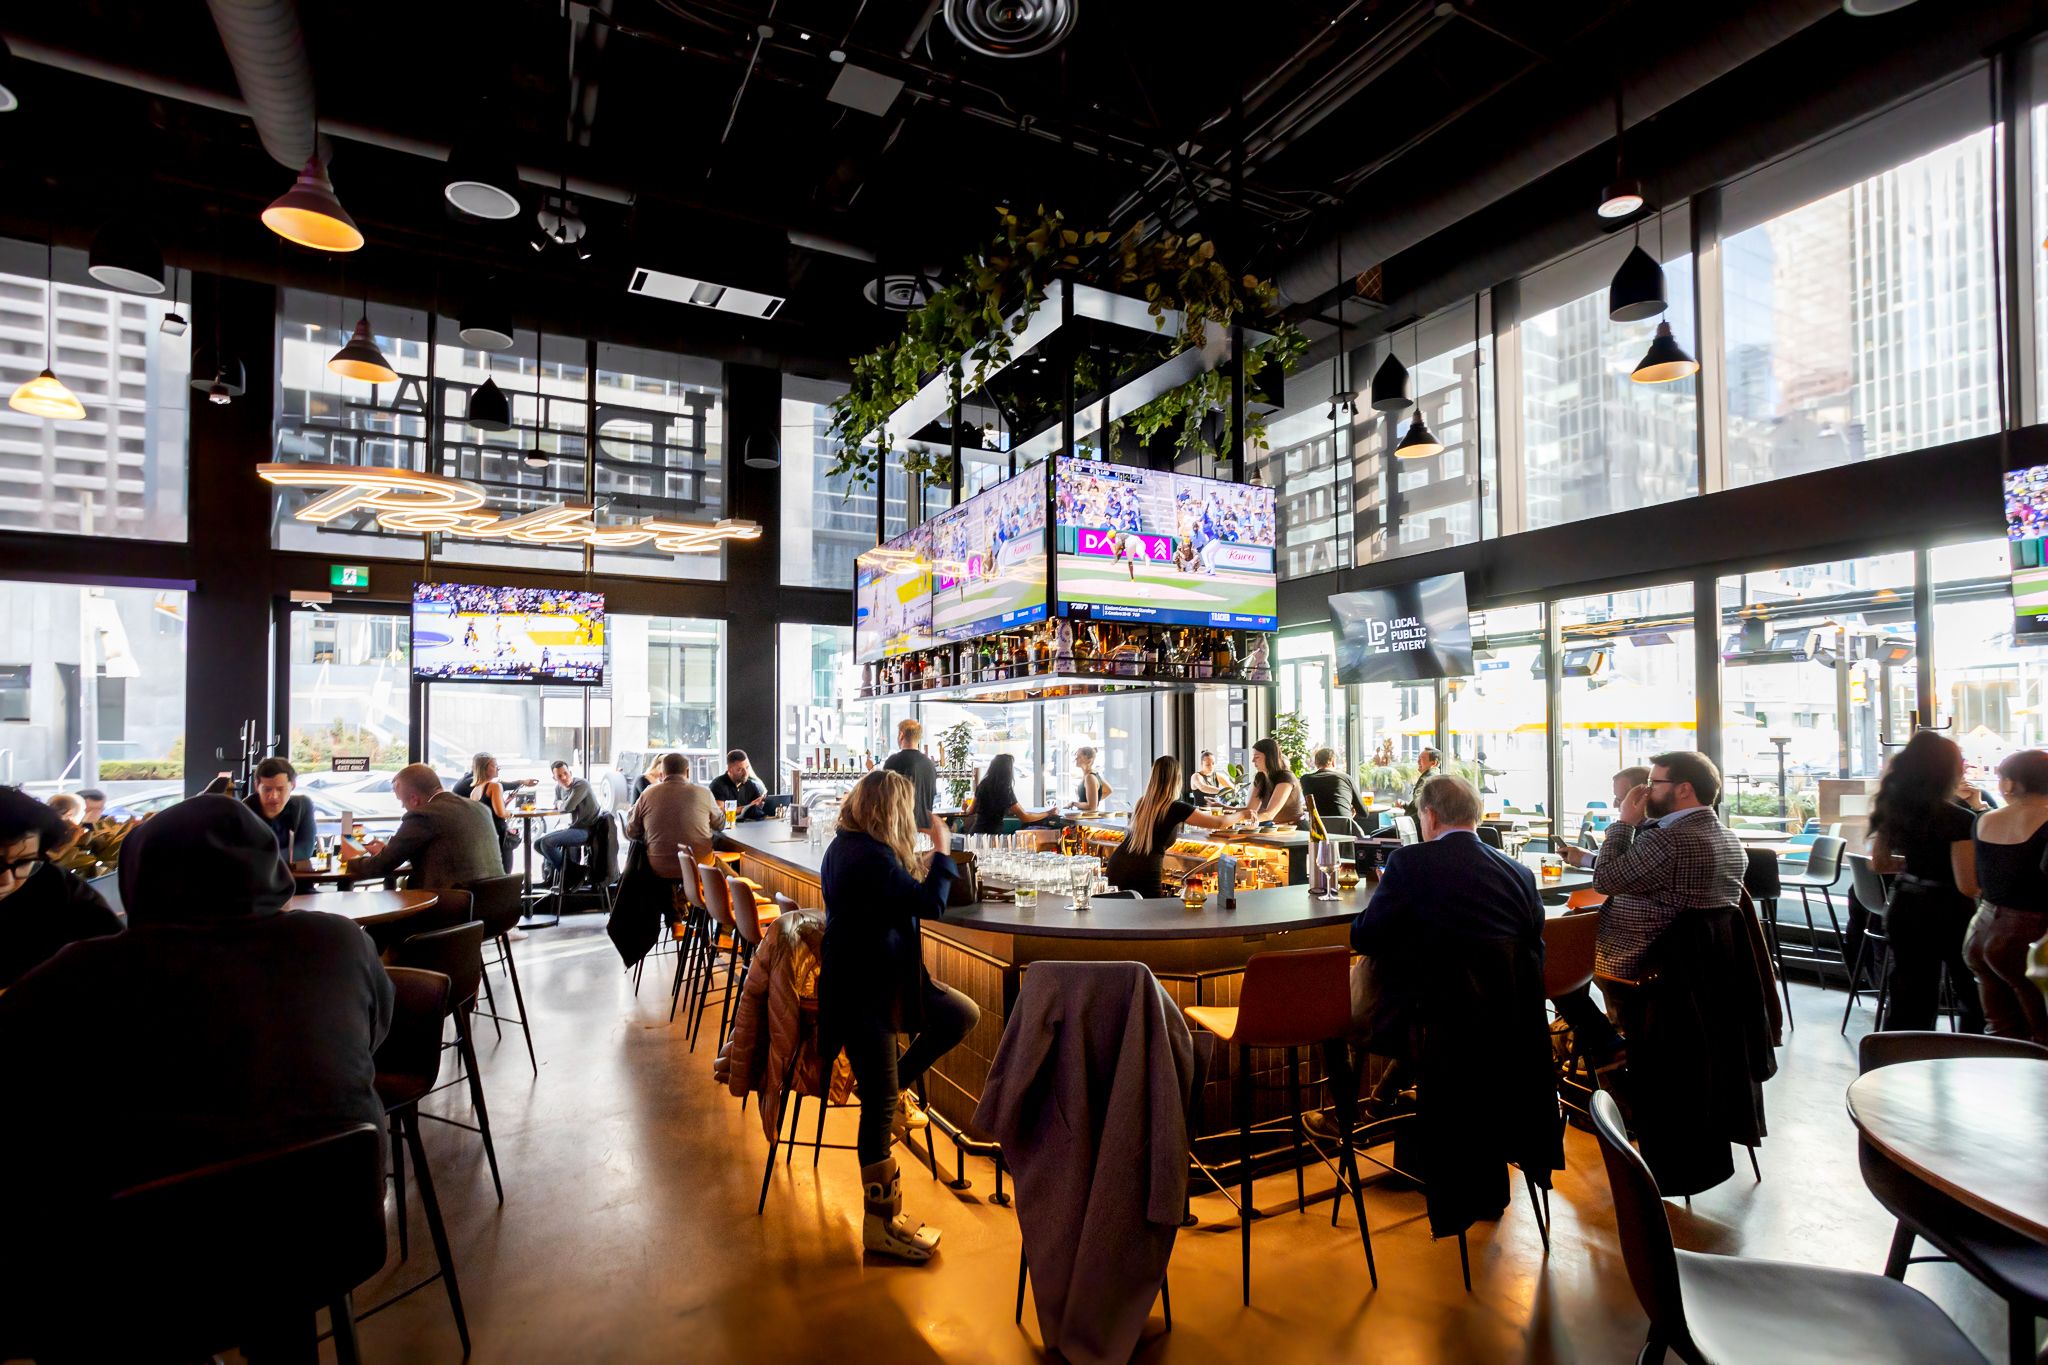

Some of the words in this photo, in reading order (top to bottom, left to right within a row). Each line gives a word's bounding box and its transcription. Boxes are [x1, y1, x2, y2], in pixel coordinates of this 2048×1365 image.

[256, 463, 763, 552] Pabst
[1390, 617, 1419, 629] LOCAL
[1391, 627, 1427, 640] PUBLIC
[1392, 639, 1426, 652] EATERY
